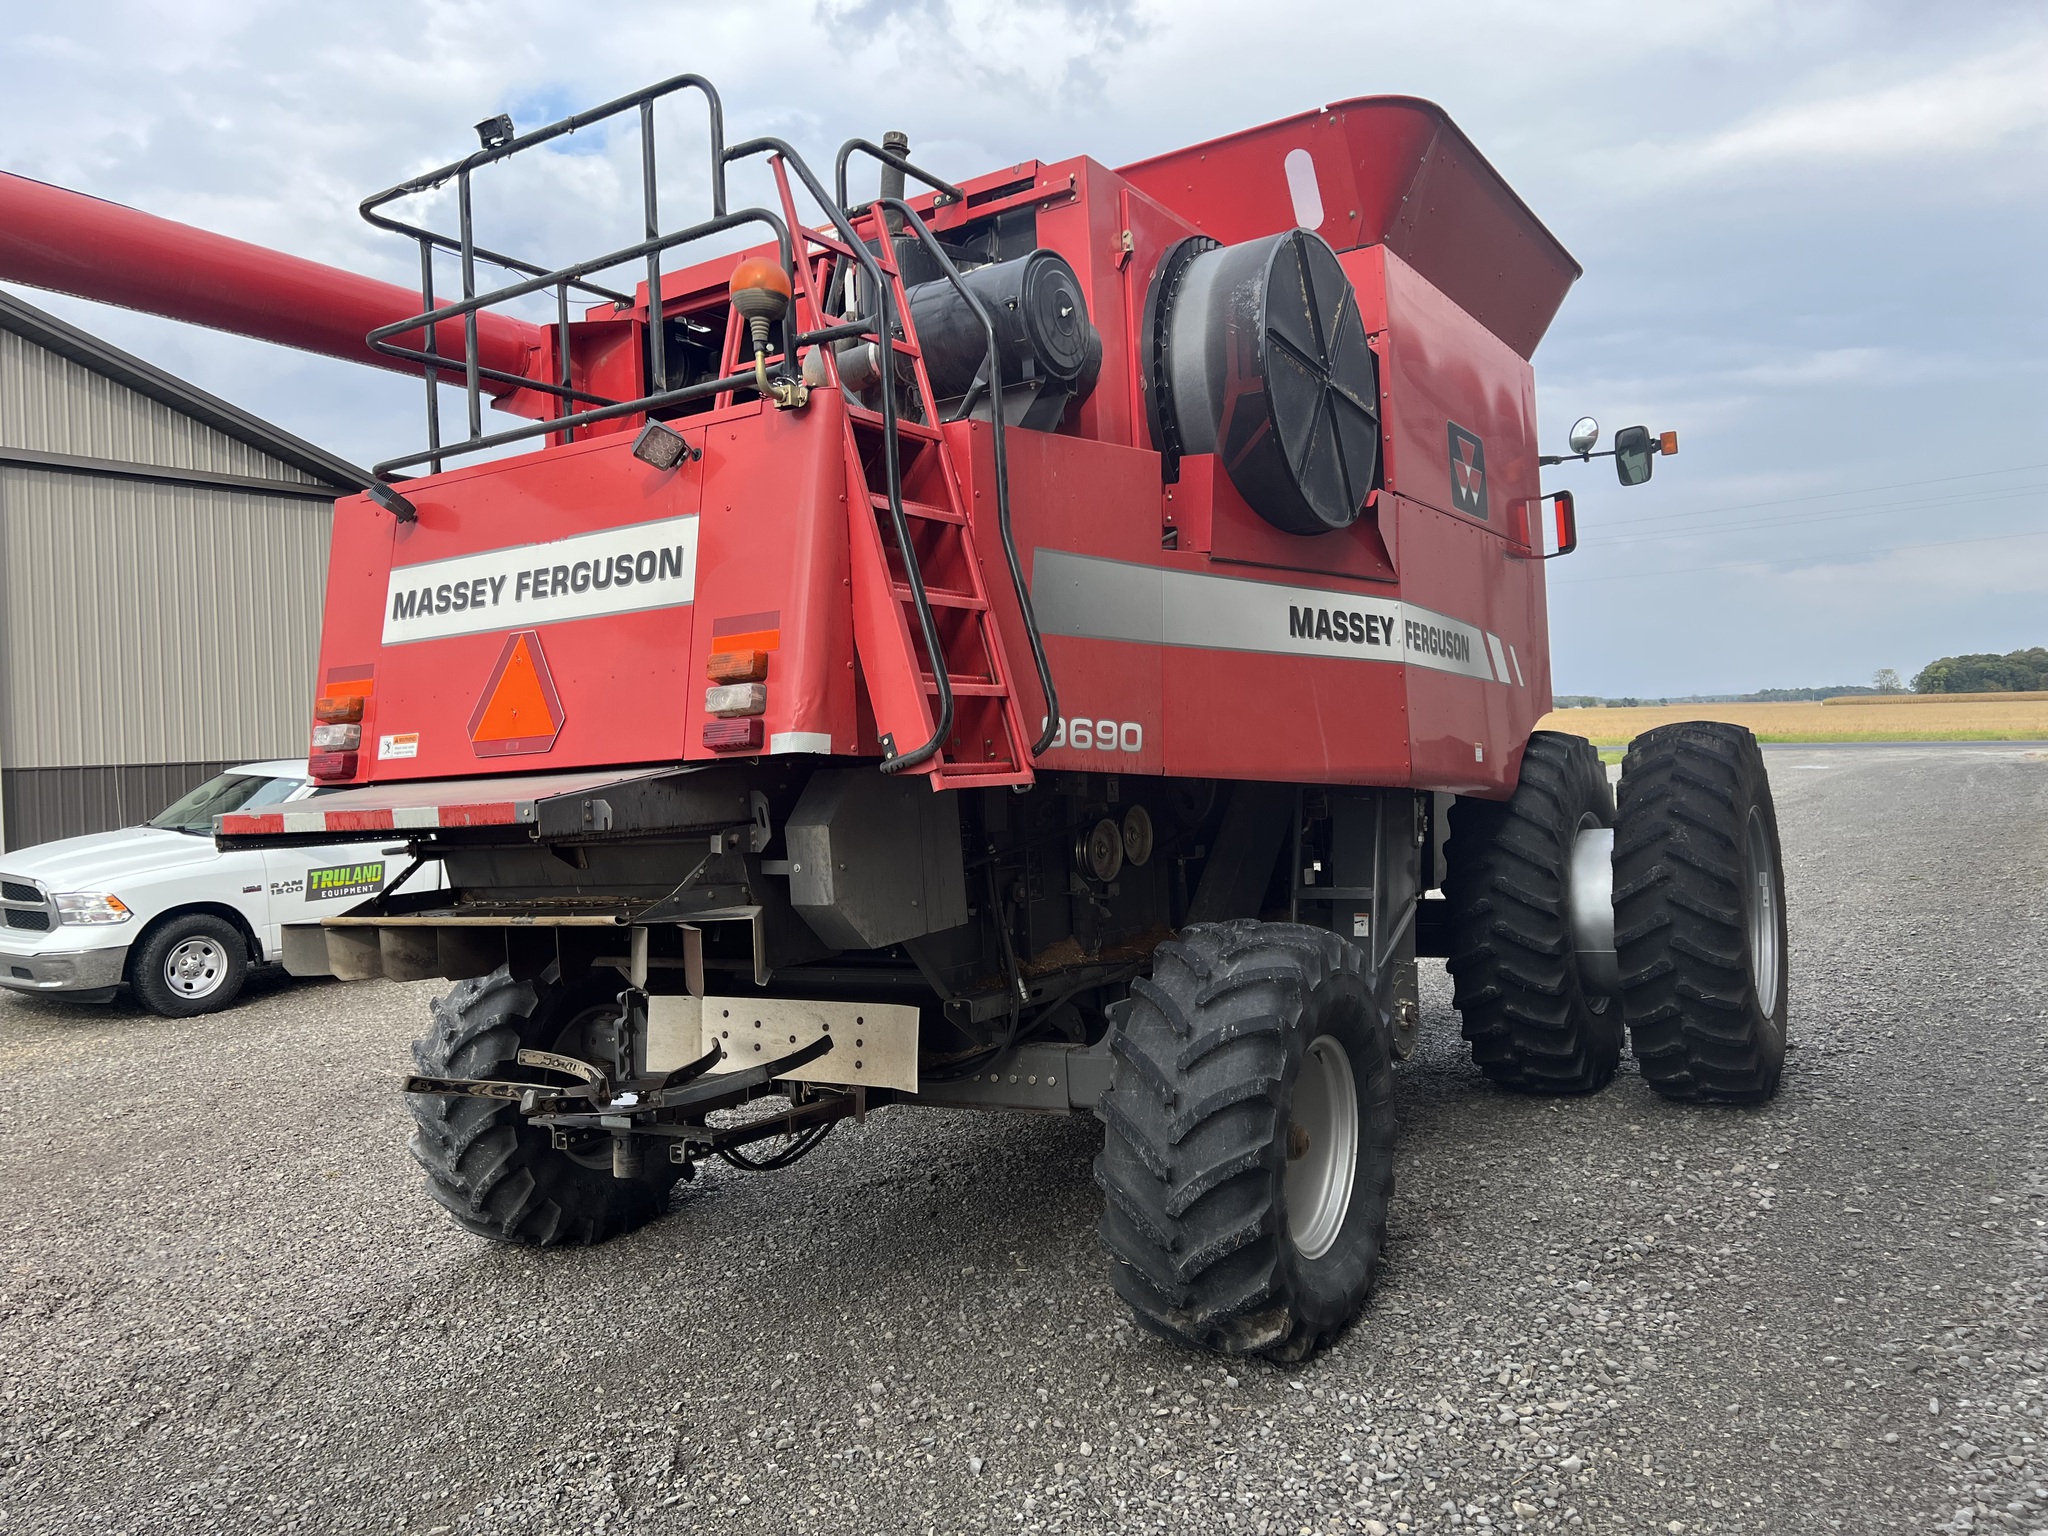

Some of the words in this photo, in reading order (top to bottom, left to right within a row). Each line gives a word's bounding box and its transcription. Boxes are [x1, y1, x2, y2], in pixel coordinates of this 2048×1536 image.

[392, 575, 507, 621] MASSEY
[515, 545, 684, 603] FERGUSON
[1289, 605, 1394, 646] MASSEY
[1405, 619, 1470, 663] FERGUSON
[1042, 715, 1142, 752] 9690
[270, 879, 303, 889] RAM
[310, 864, 382, 890] TRULAND
[270, 886, 304, 896] 1500
[321, 884, 374, 898] EQUIPMENT
